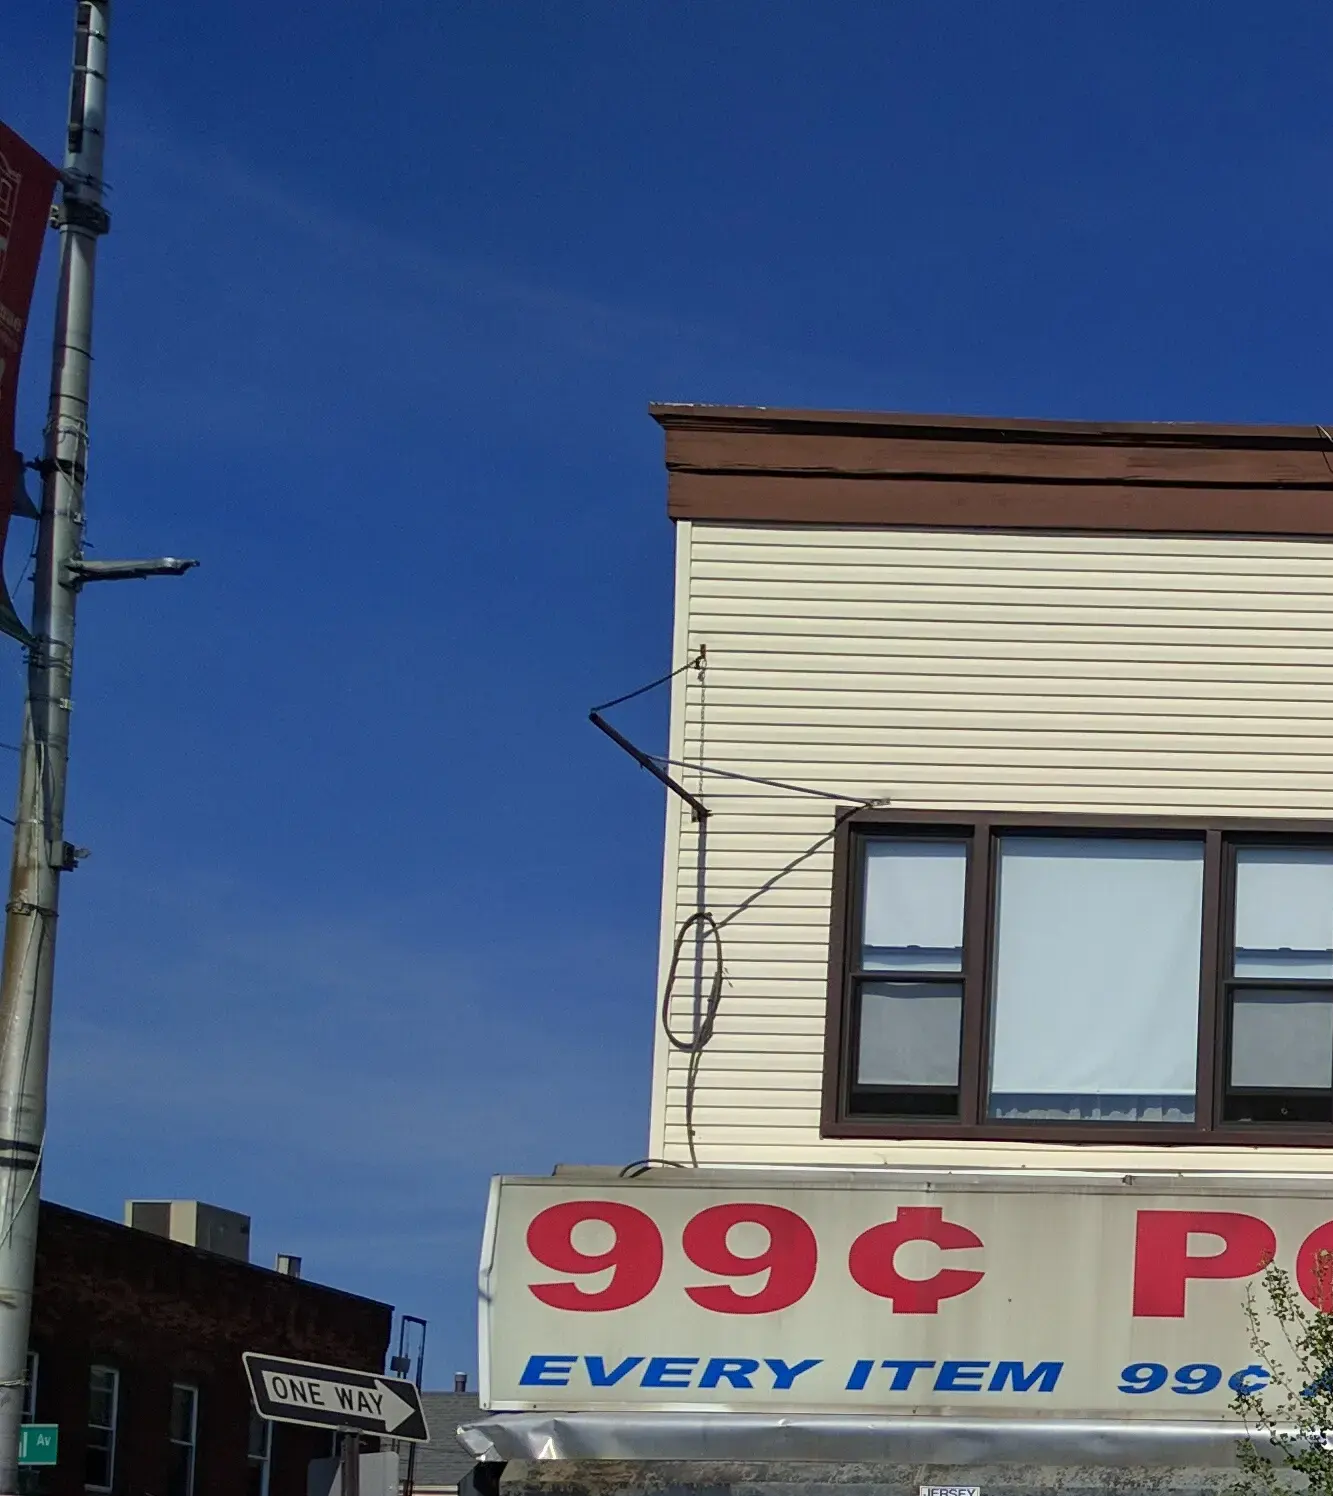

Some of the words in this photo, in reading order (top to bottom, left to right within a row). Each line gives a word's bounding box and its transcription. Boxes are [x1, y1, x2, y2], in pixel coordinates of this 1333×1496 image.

[527, 1200, 985, 1314] 99¢
[271, 1376, 325, 1406] ONE
[334, 1386, 383, 1416] WAY
[519, 1355, 825, 1390] EVERY
[845, 1359, 1063, 1393] ITEM
[1117, 1362, 1273, 1396] 99¢
